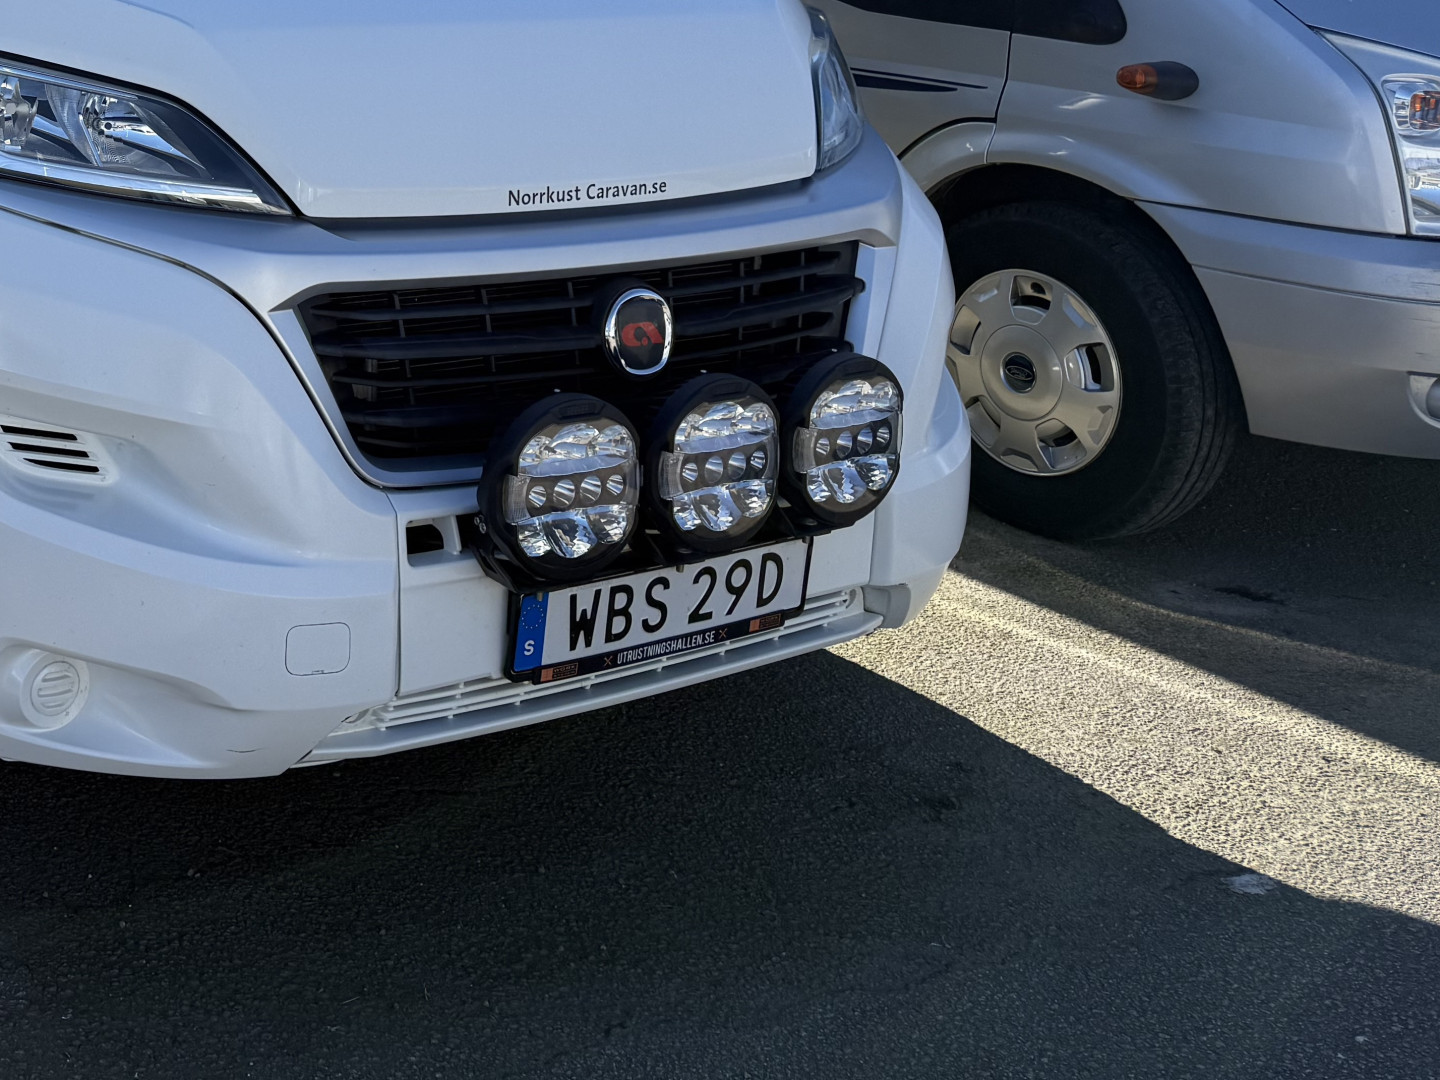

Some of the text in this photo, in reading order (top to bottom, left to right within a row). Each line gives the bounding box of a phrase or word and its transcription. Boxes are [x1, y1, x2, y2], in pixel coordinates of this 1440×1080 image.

[508, 181, 667, 207] Norrkust Caravan.se
[568, 552, 784, 652] WBS 29D
[524, 640, 535, 656] S
[617, 631, 716, 665] UTRUSTNINGSHALLEN.SE
